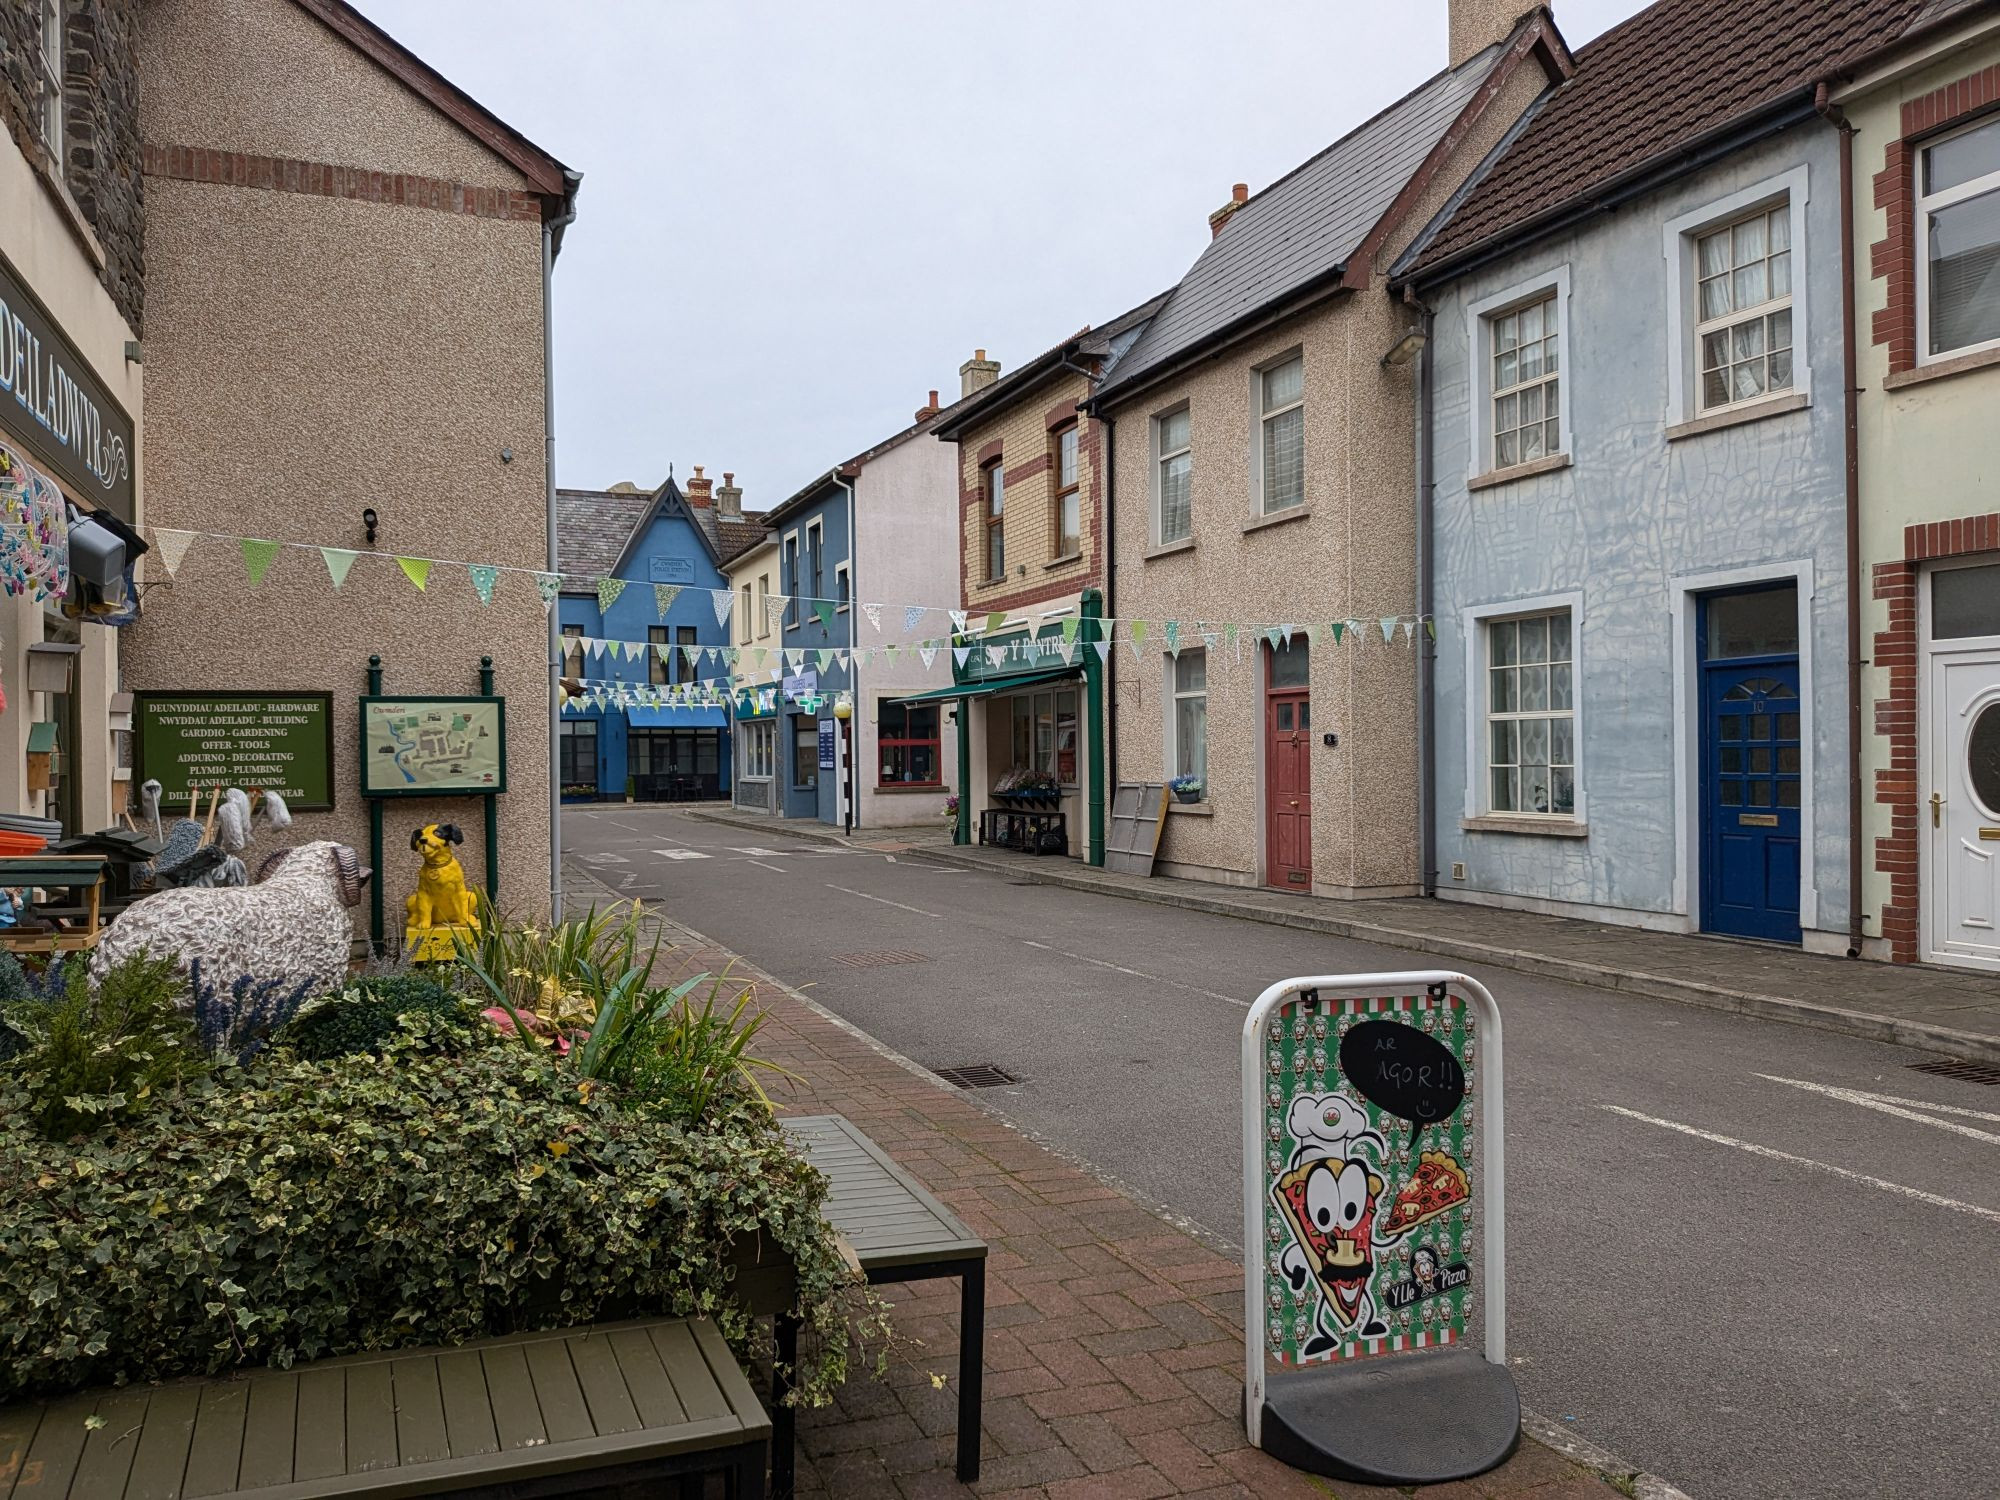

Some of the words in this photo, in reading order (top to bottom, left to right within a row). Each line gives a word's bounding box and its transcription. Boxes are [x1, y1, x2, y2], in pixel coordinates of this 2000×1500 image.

[1011, 639, 1020, 661] Y
[149, 703, 212, 713] DEUNYDDIAU
[213, 703, 261, 713] ADEILADU
[267, 703, 320, 712] HARDWARE
[159, 716, 208, 725] NWYDDAU
[209, 716, 256, 725] ADEILADU
[262, 715, 308, 725] BUILDING
[181, 728, 226, 738] GARDDIO
[232, 728, 288, 737] GARDENING
[201, 741, 232, 750] OFFER
[239, 740, 271, 749] TOOLS
[177, 753, 225, 763] ADDURNO
[232, 752, 294, 762] DECORATING
[189, 766, 227, 775] PLYMIO
[233, 765, 283, 774] PLUMBING
[187, 778, 232, 787] GLANHAU
[238, 777, 286, 787] CLEANING
[168, 790, 204, 801] DILLD
[1374, 1037, 1397, 1051] AR
[1391, 1285, 1400, 1306] Y
[1440, 1268, 1466, 1289] Pizza
